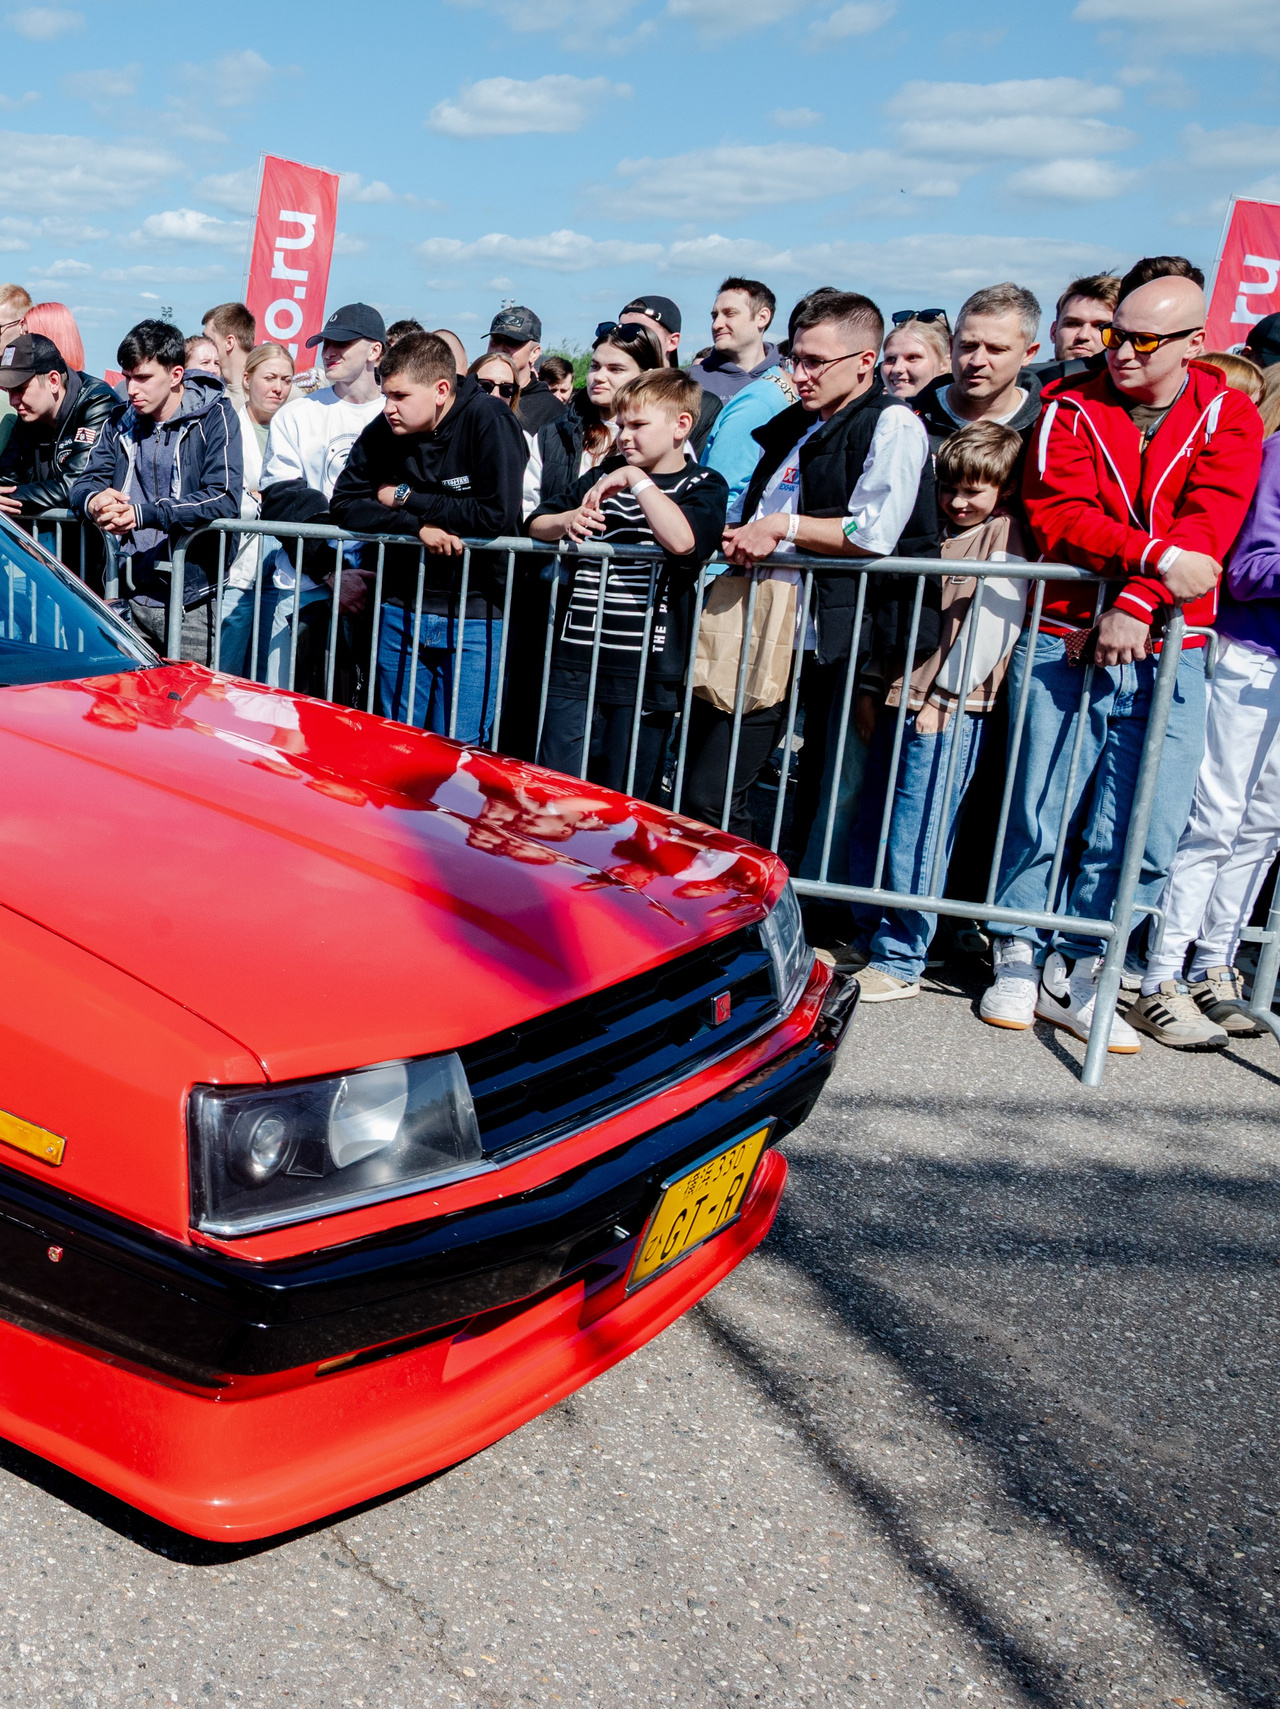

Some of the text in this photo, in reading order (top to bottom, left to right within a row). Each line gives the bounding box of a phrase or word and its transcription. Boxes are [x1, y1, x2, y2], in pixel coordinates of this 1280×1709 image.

[652, 625, 667, 652] THE
[713, 1144, 746, 1183] 330
[660, 1172, 745, 1260] GT-R
